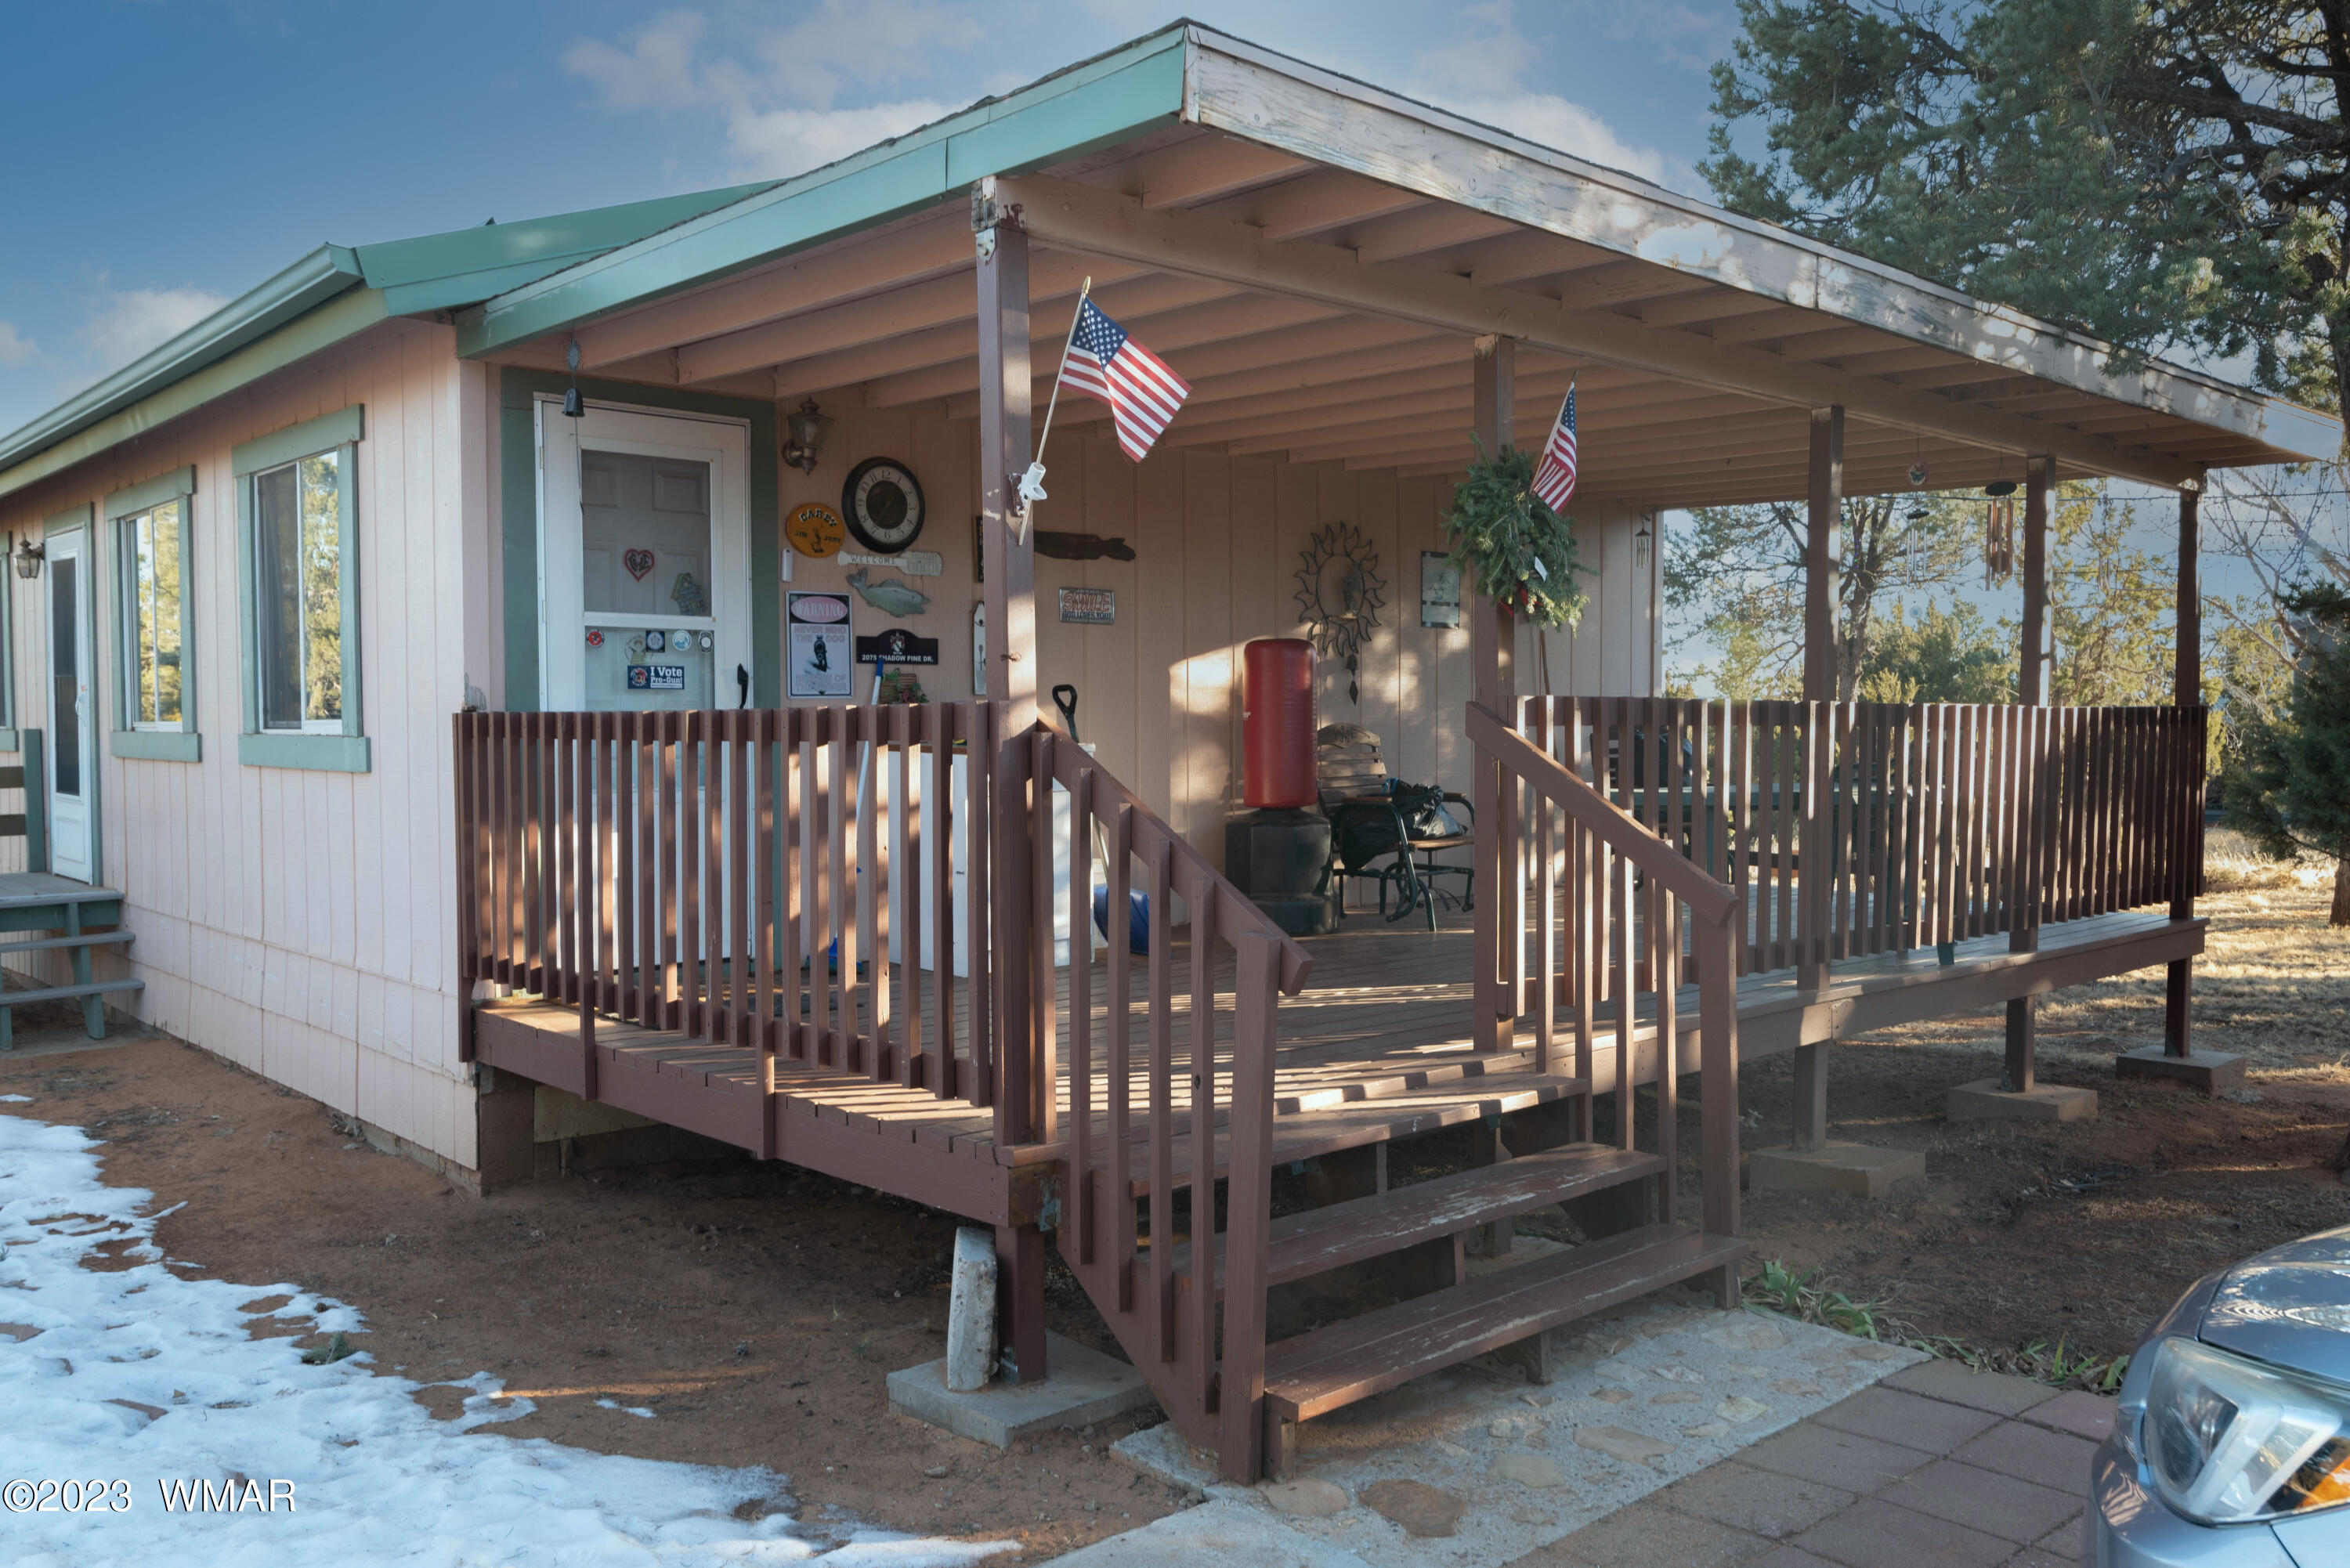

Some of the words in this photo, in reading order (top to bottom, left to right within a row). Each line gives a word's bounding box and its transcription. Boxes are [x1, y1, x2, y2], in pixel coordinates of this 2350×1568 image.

[882, 470, 891, 480] 12
[896, 475, 902, 485] 1
[904, 487, 913, 497] 2
[851, 555, 896, 565] WELCOME
[1063, 592, 1110, 612] SMILE
[795, 602, 844, 617] WARNING
[1076, 611, 1095, 620] LOVES
[794, 625, 823, 634] NEVER
[651, 667, 655, 676] I
[657, 667, 682, 676] Vote
